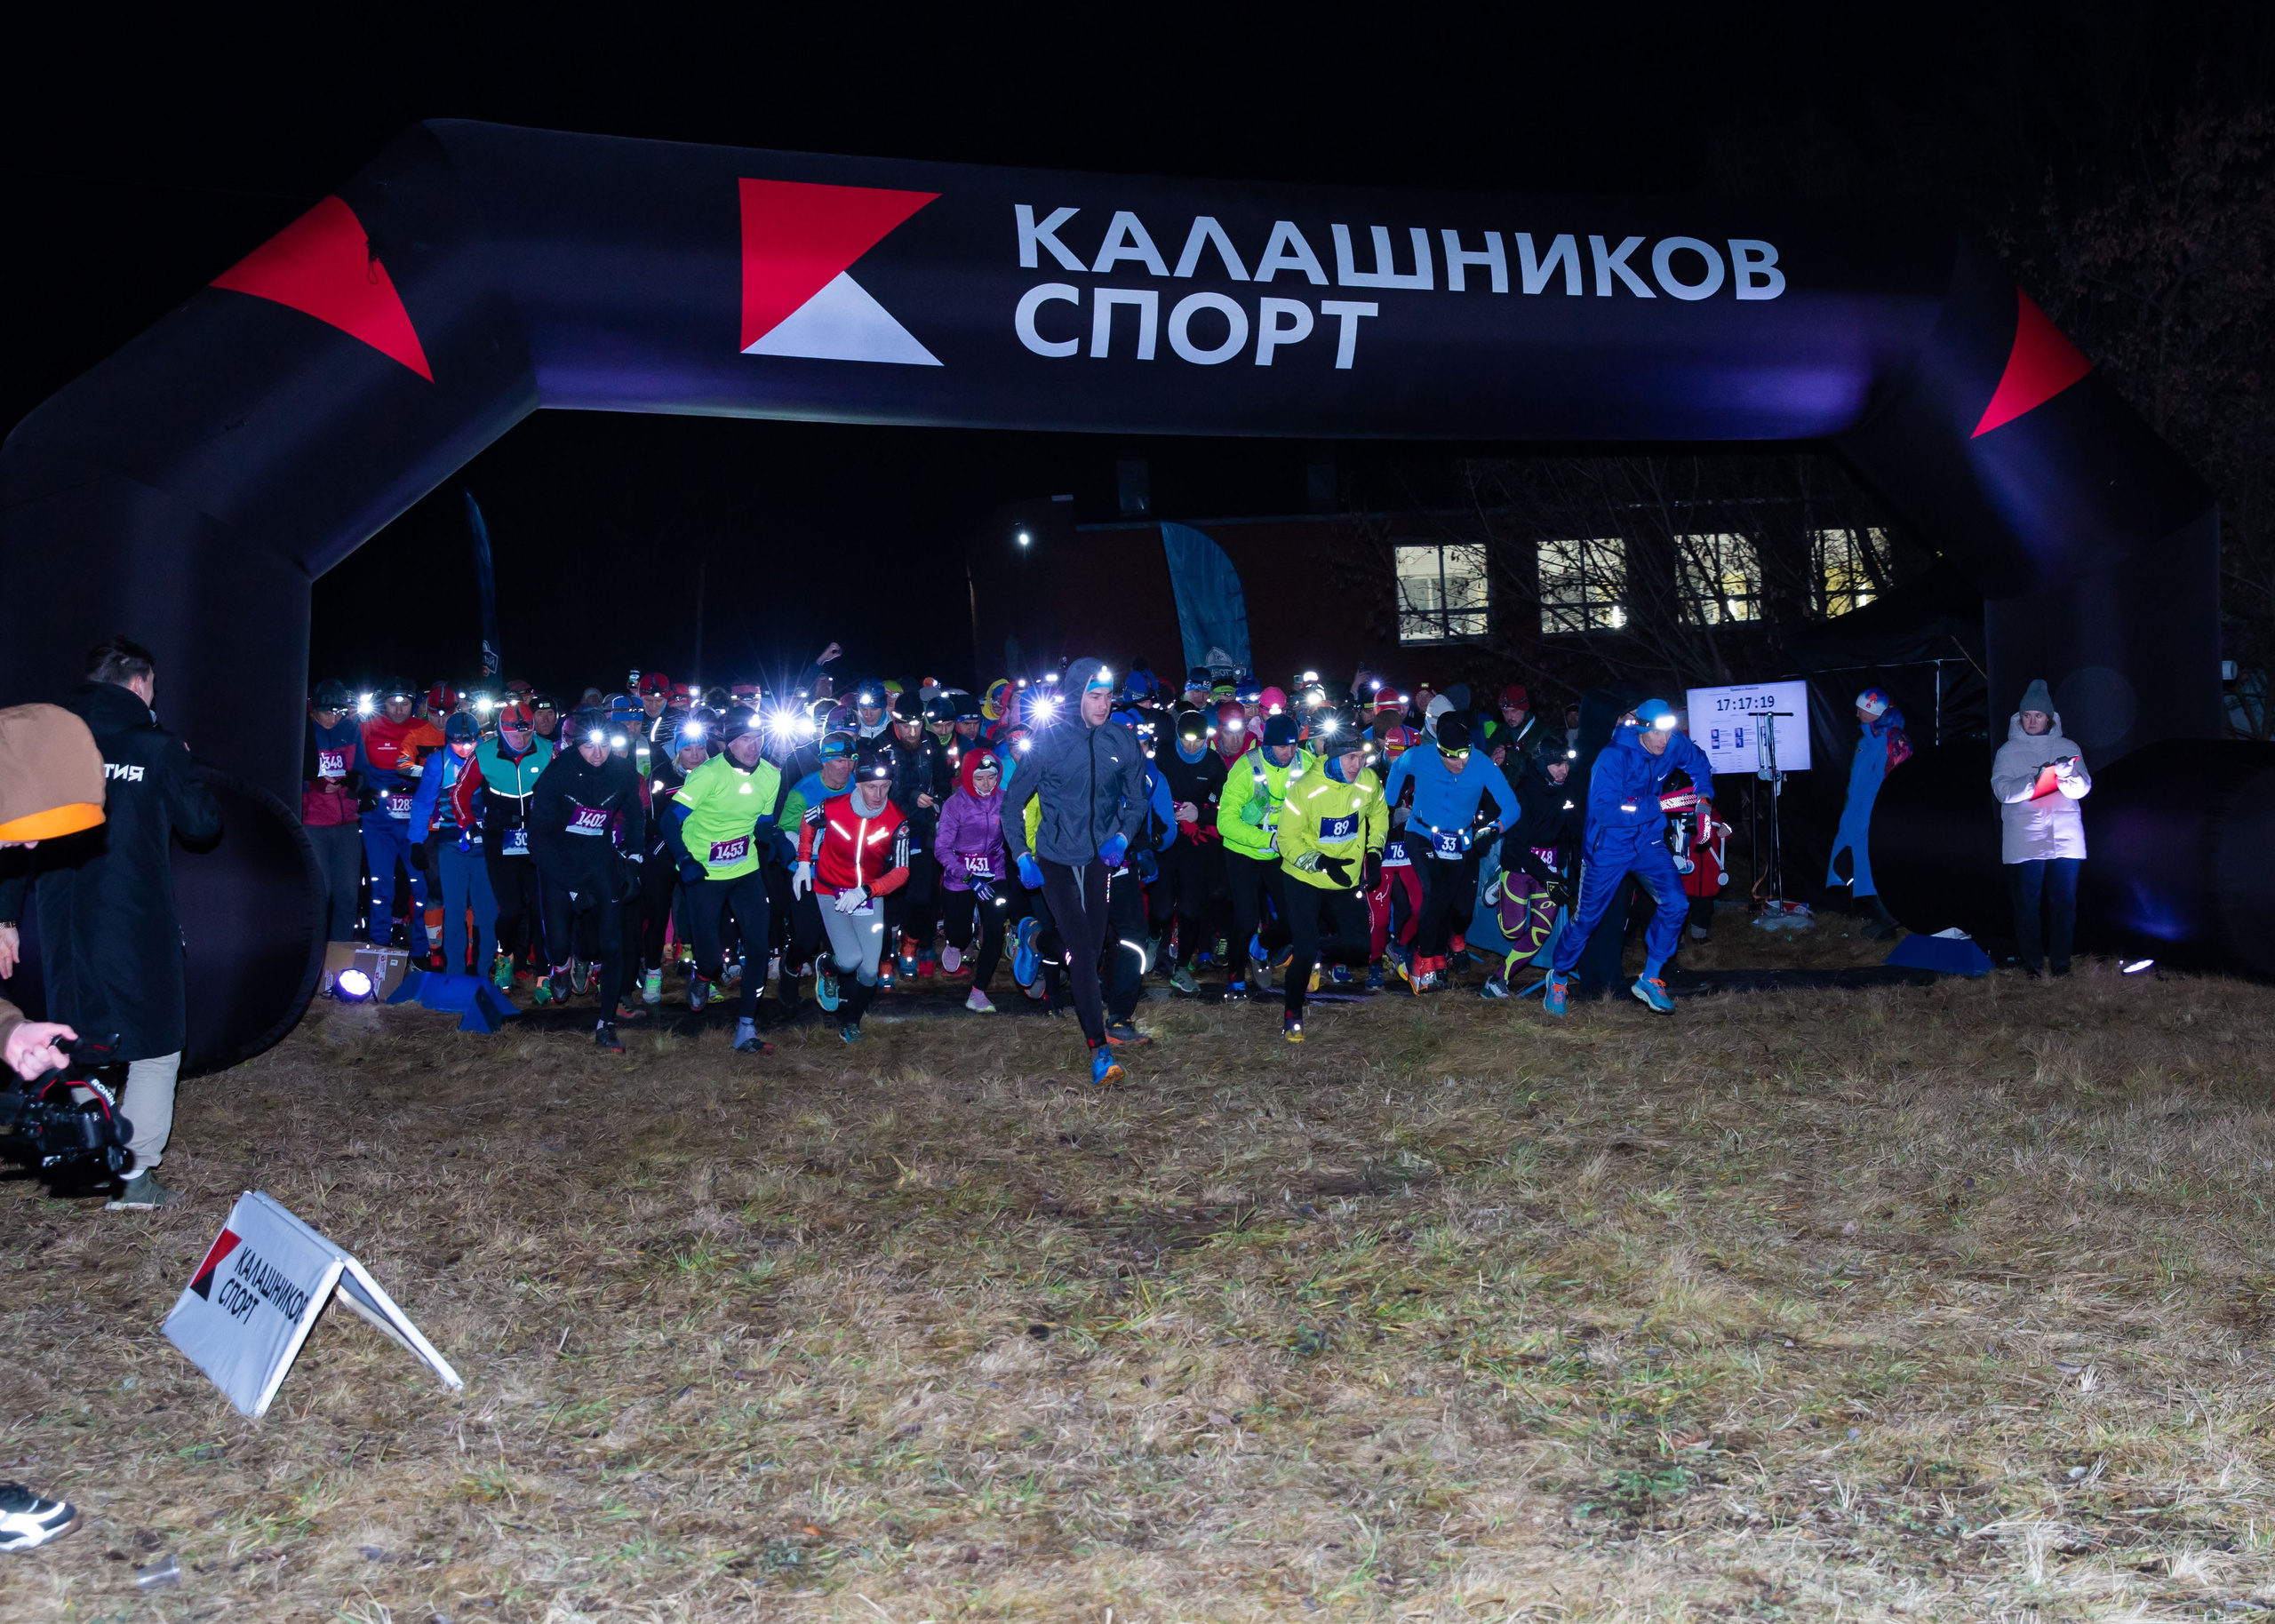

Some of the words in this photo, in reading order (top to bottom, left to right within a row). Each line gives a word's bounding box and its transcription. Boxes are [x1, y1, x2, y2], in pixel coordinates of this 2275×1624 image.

[1014, 203, 1786, 302] КАЛАШНИКОВ
[1014, 282, 1379, 370] СПОРТ
[1716, 696, 1775, 712] 17:17:19
[576, 811, 607, 828] 1402
[1333, 820, 1350, 836] 89
[715, 840, 744, 859] 1453
[1391, 845, 1405, 859] 76
[1441, 836, 1457, 852] 33
[964, 856, 990, 872] 1431
[91, 1078, 116, 1107] RONIN
[235, 1246, 309, 1325] КАЛАШНИКОВ
[218, 1278, 260, 1325] СПОРТ
